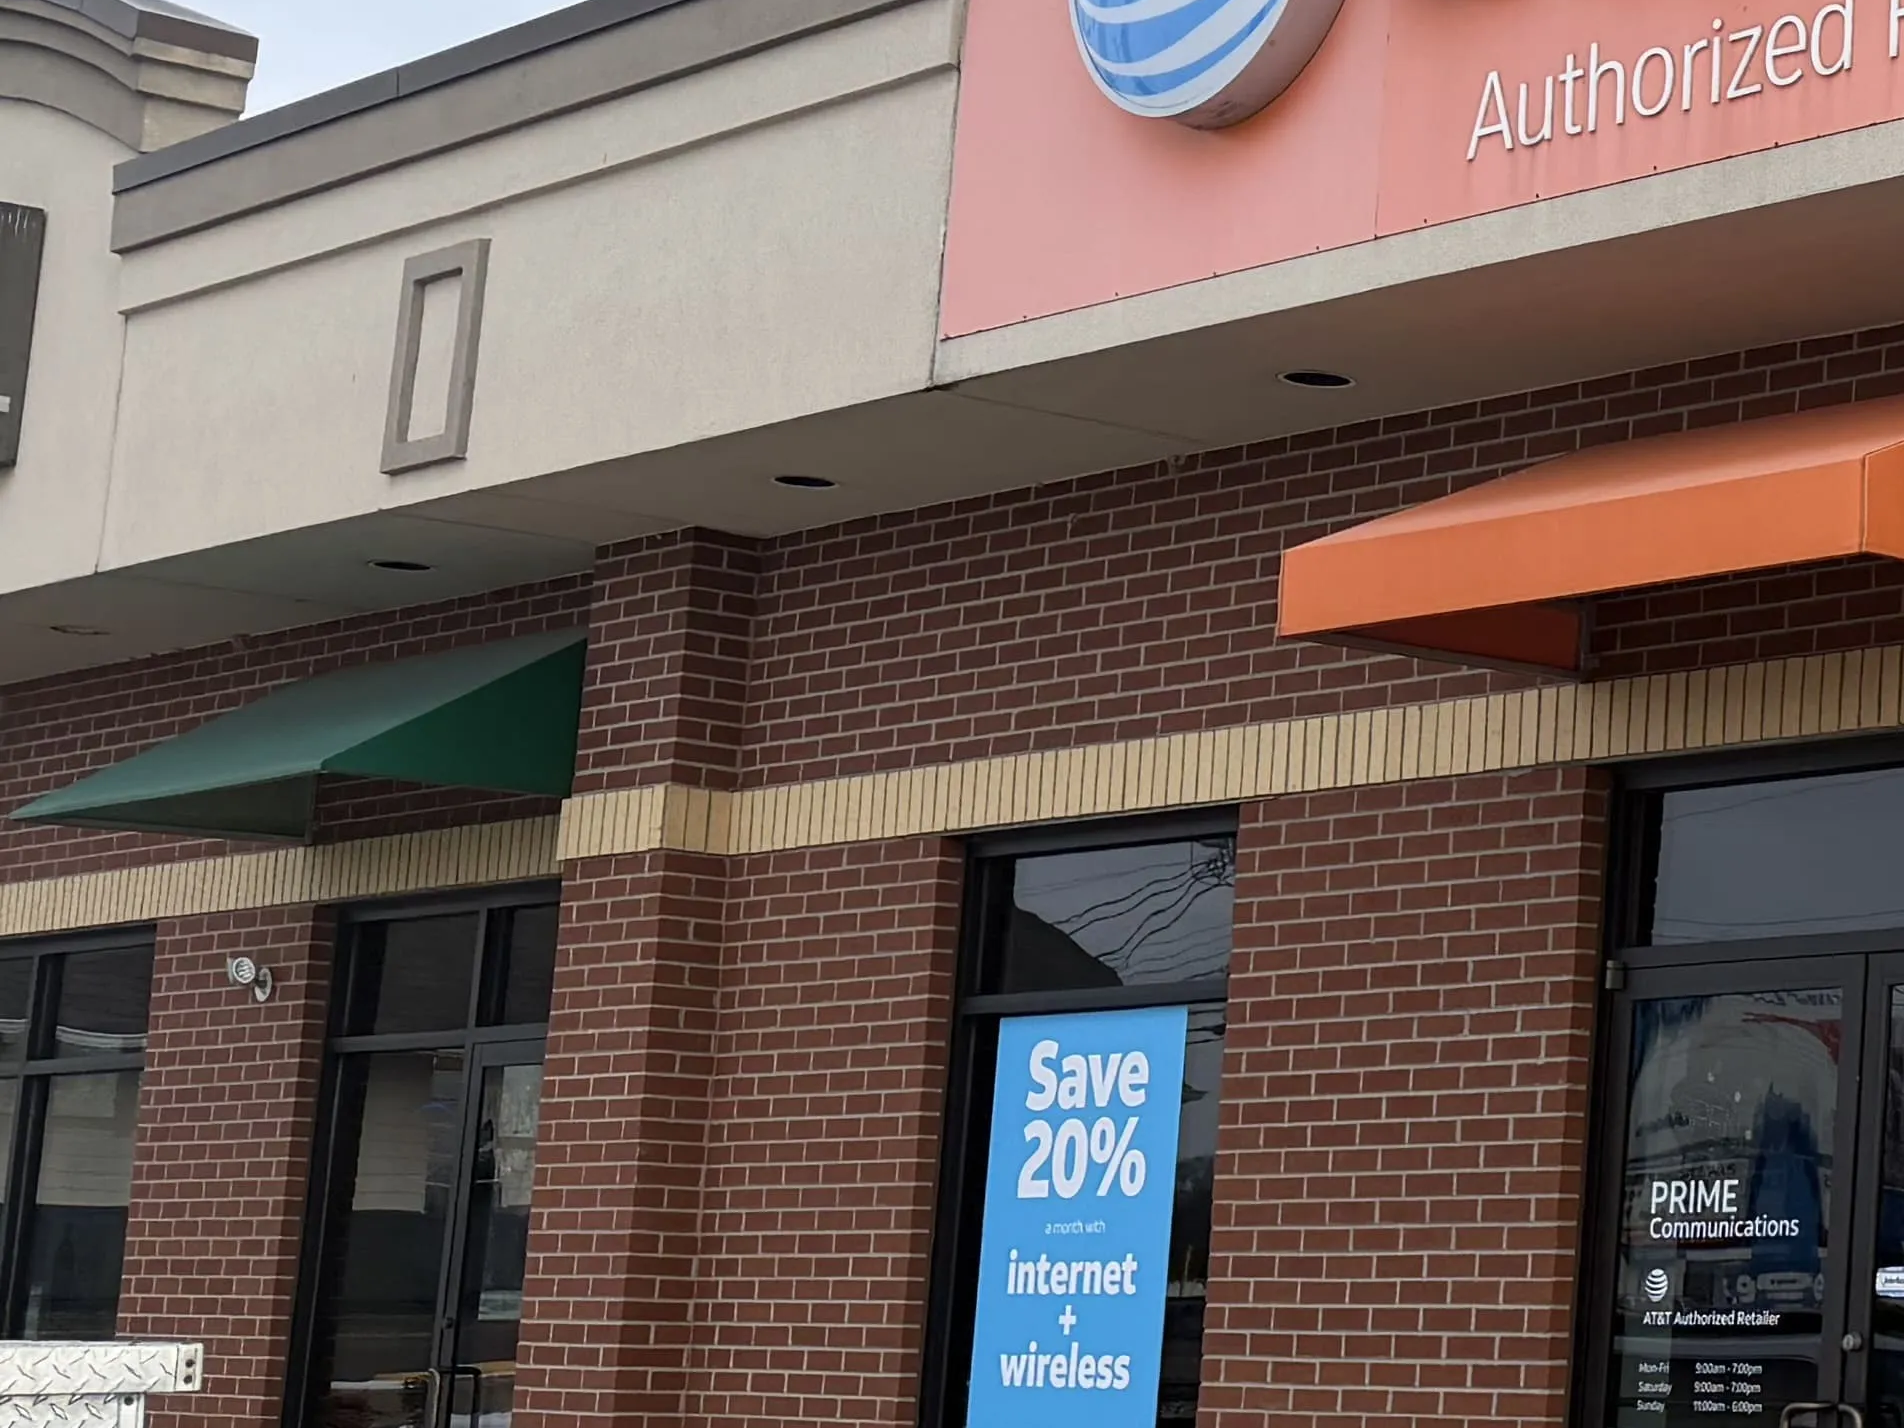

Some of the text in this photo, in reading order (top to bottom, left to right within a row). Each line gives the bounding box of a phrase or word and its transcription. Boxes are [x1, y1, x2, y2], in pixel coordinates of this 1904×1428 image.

[1025, 1039, 1149, 1112] Save
[1017, 1116, 1146, 1199] 20%
[1650, 1179, 1740, 1215] PRIME
[1044, 1223, 1052, 1235] a
[1649, 1214, 1801, 1240] Communications
[1007, 1248, 1139, 1295] internet
[1058, 1304, 1077, 1335] +
[1643, 1309, 1781, 1326] AT&T Authorized Retailer
[999, 1340, 1131, 1390] wireless
[1638, 1381, 1673, 1396] Saturday
[1636, 1399, 1666, 1414] Sunday
